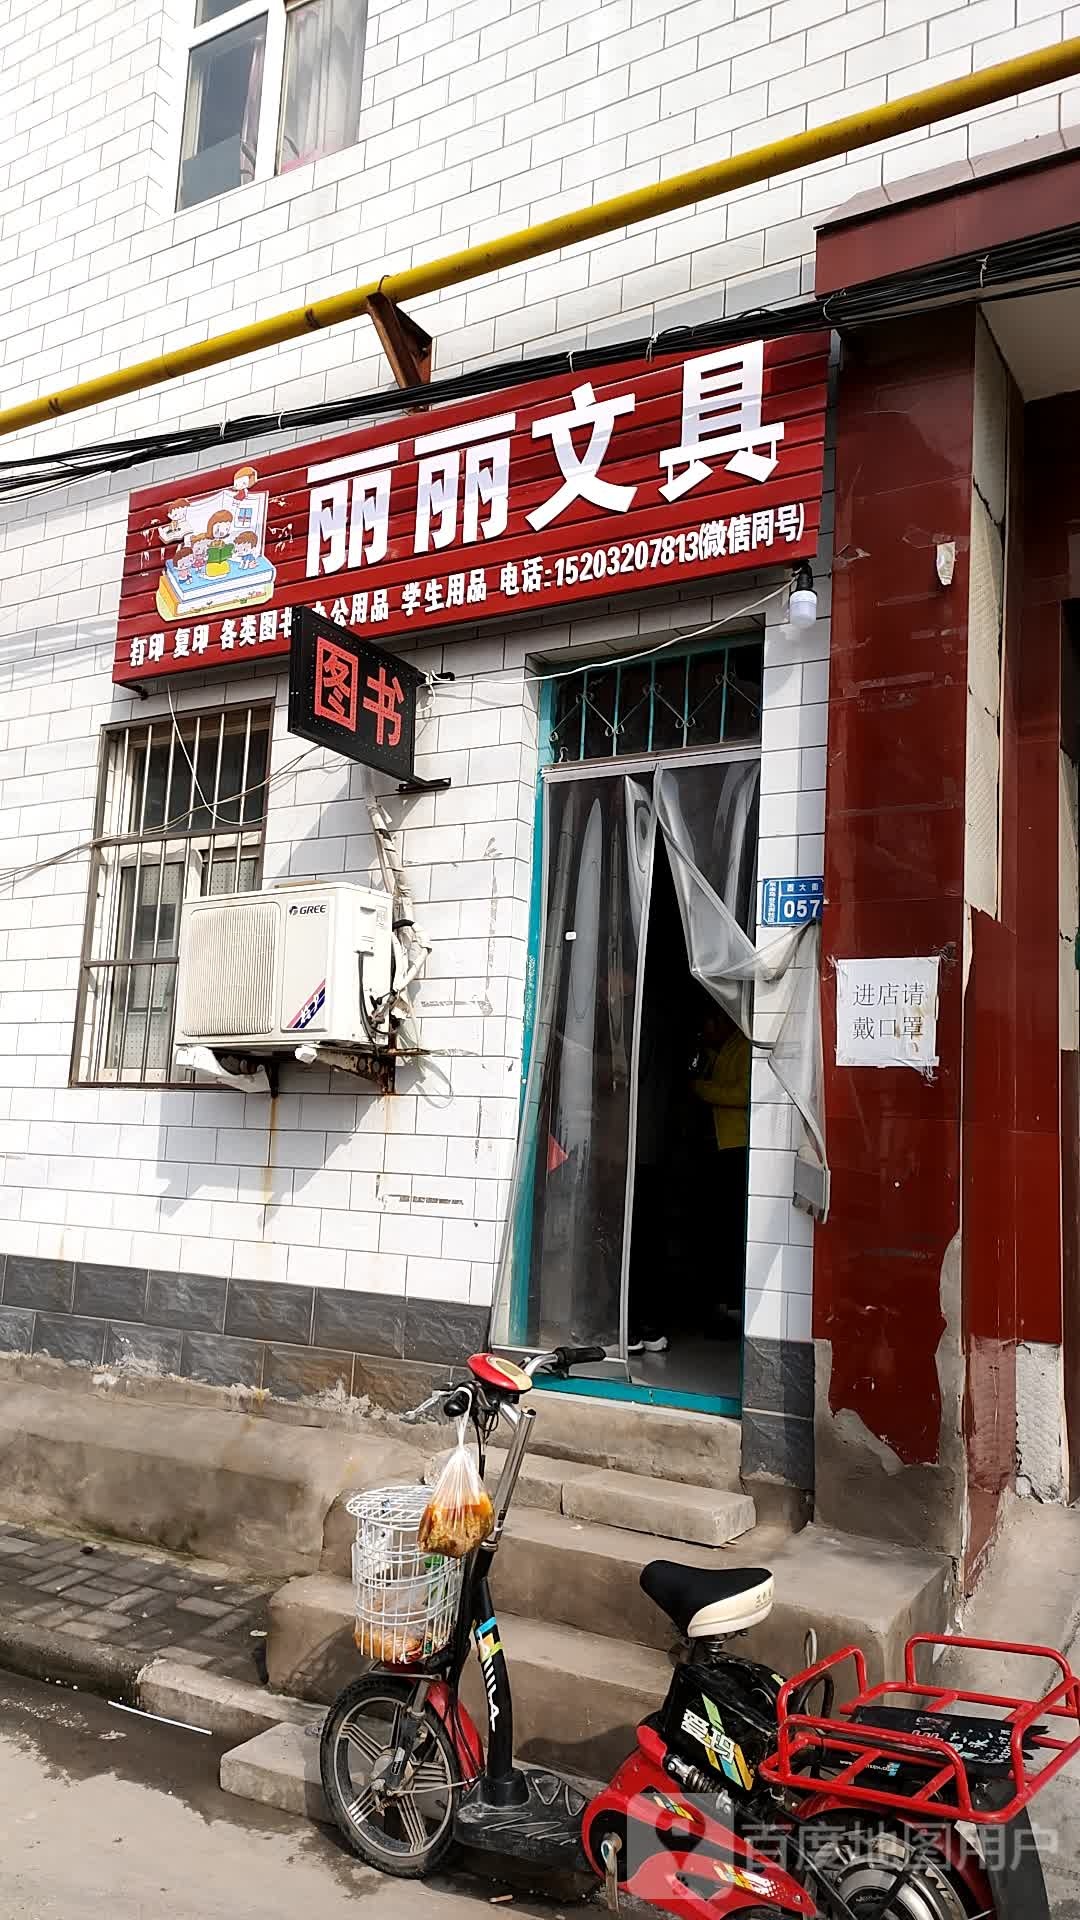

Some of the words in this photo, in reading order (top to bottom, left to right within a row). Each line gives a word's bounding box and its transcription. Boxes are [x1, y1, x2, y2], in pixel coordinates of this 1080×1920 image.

[305, 339, 785, 579] 丽丽文具
[129, 632, 165, 667] 打印
[172, 624, 210, 659] 复印
[401, 568, 487, 616] 学生用品
[314, 636, 405, 747] 图书
[299, 904, 327, 915] GREE
[783, 899, 821, 919] 057
[852, 981, 925, 1006] 进店请
[852, 1016, 924, 1040] 戴口罩
